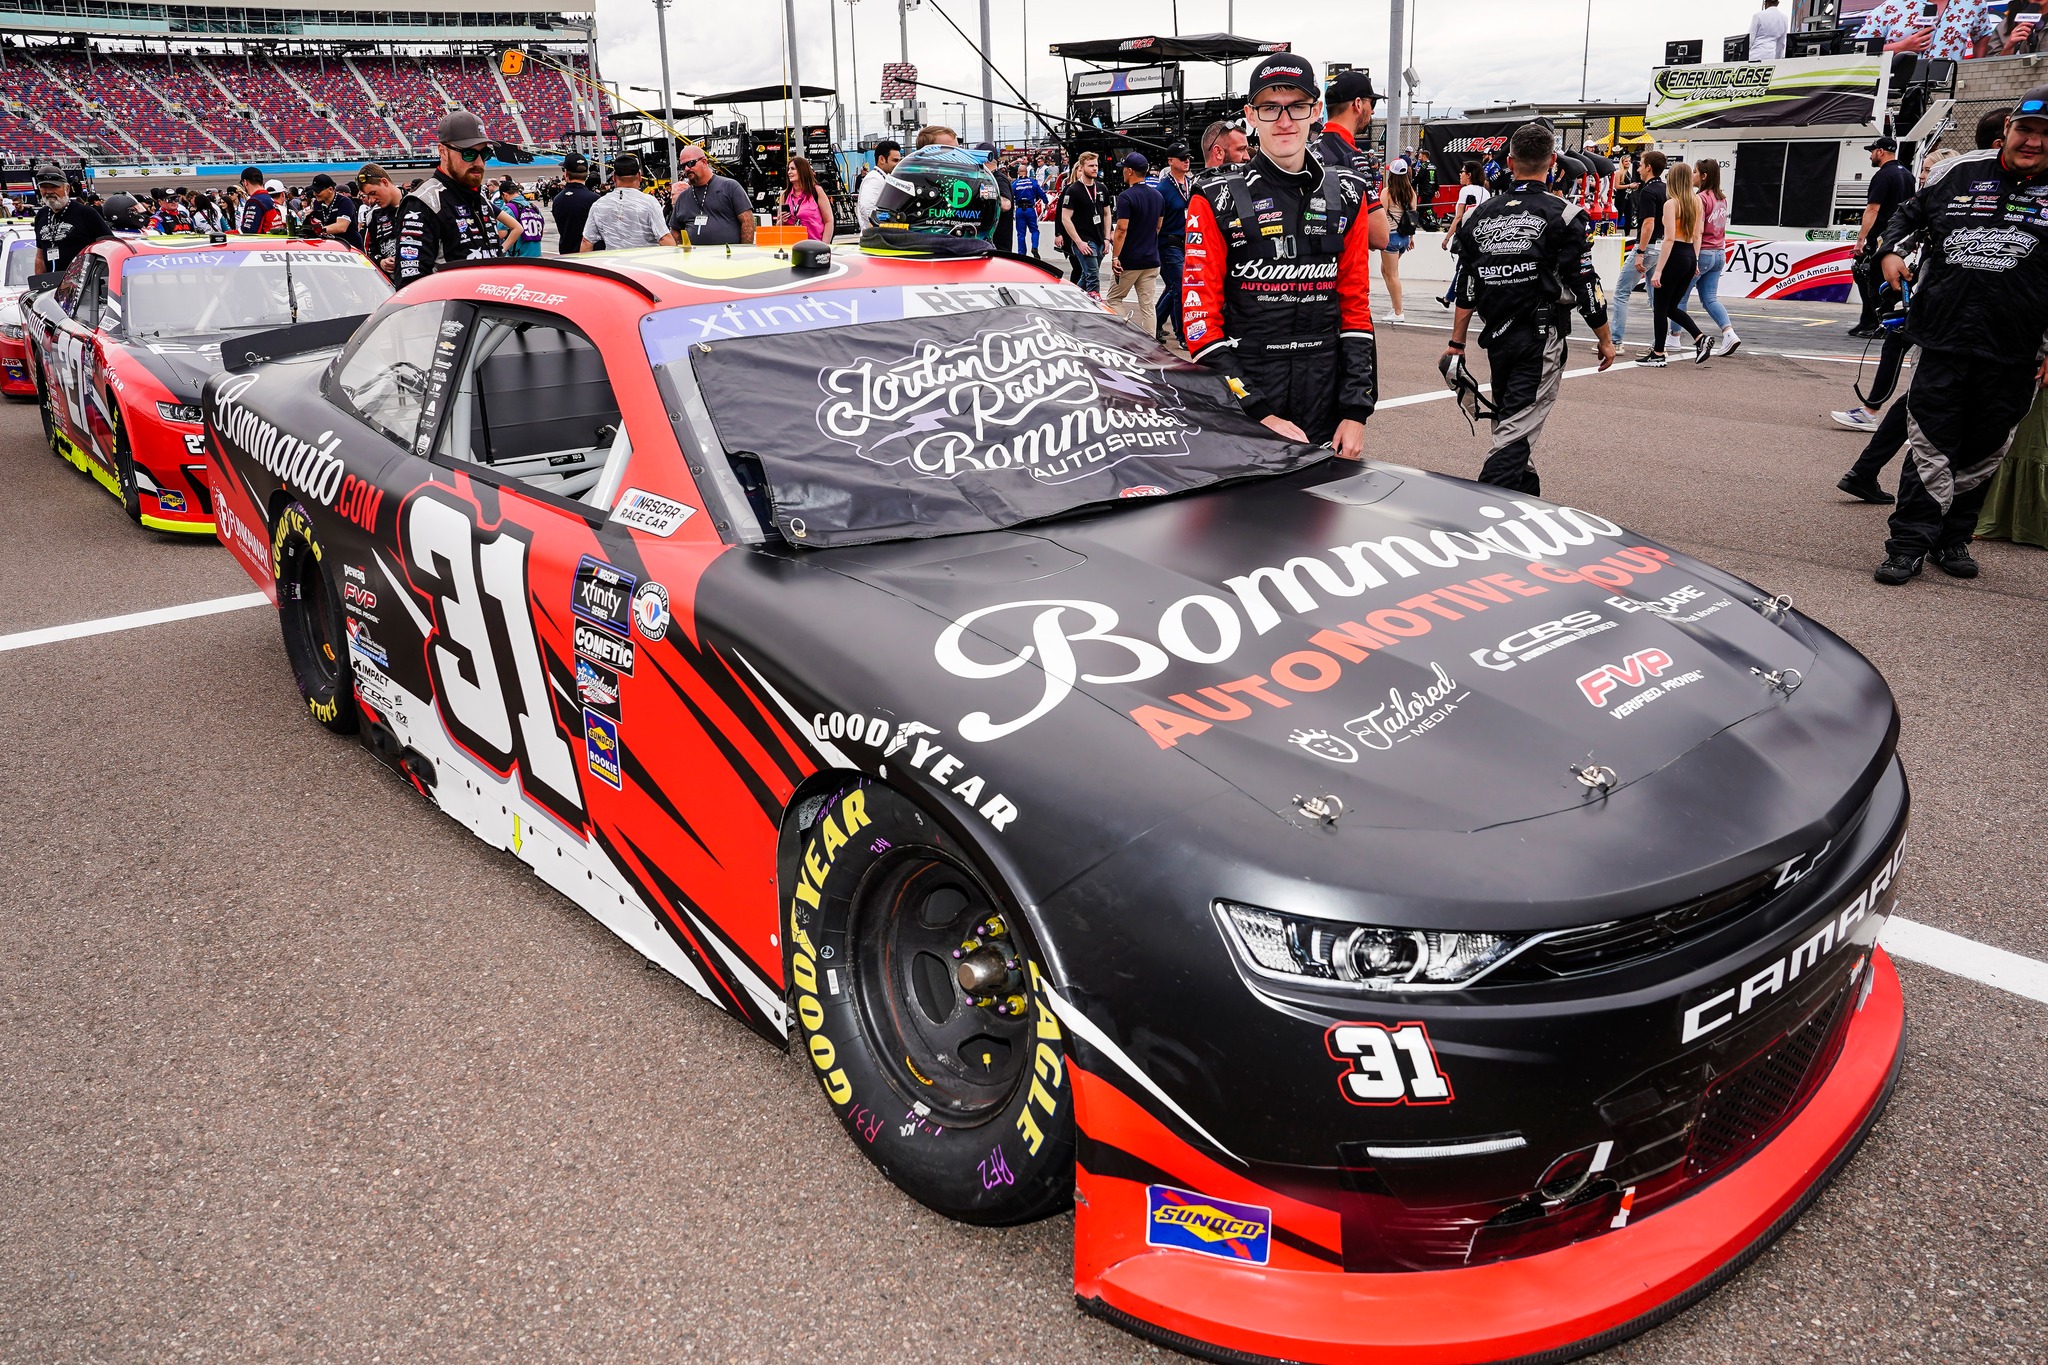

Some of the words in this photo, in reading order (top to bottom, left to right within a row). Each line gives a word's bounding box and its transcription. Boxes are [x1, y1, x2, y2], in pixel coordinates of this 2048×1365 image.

[1132, 37, 1155, 49] RCR
[1259, 65, 1303, 78] Bommarito
[1685, 87, 1769, 102] Motorsports
[709, 139, 739, 157] JARRETT
[1465, 136, 1508, 152] RCR
[1718, 160, 1730, 168] ps
[928, 208, 981, 219] FUNKAWAY
[1189, 232, 1203, 244] 75
[1480, 238, 1532, 251] Bommarito
[1943, 227, 1986, 247] Jordan
[1980, 226, 2037, 250] Anderson
[146, 254, 225, 269] xfinity
[260, 252, 358, 264] BURTON
[1478, 262, 1537, 278] EASYCARE
[1948, 250, 2018, 268] Bommarito
[1240, 281, 1314, 292] AUTOMOTIVE
[1775, 276, 1797, 291] Made
[1797, 272, 1805, 283] in
[1806, 265, 1840, 278] America
[475, 283, 508, 297] PARKER
[518, 290, 568, 306] RETZLAFF
[689, 294, 860, 338] xfinity
[1298, 340, 1323, 348] RETZLAFF
[827, 344, 982, 437] Jordan
[948, 359, 1099, 442] Racing
[913, 403, 1187, 474] Bommarito
[1033, 430, 1179, 480] AUTOSPORT
[160, 495, 185, 506] SUNOCO
[640, 495, 681, 520] NASCAR
[620, 509, 645, 525] RACE
[645, 514, 668, 531] CAR
[228, 508, 271, 571] FUNKAWAY
[343, 563, 366, 585] pewag
[599, 568, 620, 585] NASCAR
[343, 582, 377, 609] FVP
[581, 579, 622, 618] xfinity
[1604, 584, 1706, 614] ECARE
[590, 605, 609, 620] SERIES
[933, 500, 1624, 743] Bommarito
[634, 613, 665, 640] ANNIVERSARY
[1499, 610, 1602, 652] CRS
[409, 495, 584, 811] 31
[575, 627, 633, 668] COMETIC
[579, 647, 602, 660] GASKET
[1129, 573, 1550, 750] AUTOMOTIVE
[1527, 546, 1676, 594] GOUP
[362, 664, 390, 687] IMPACT
[576, 666, 619, 698] Arrowhead
[1576, 648, 1674, 708] FVP
[309, 695, 338, 723] EAGLE
[361, 684, 393, 710] CRS
[1344, 661, 1457, 750] Tailored
[1609, 682, 1666, 720] VERIFIED.
[1410, 702, 1458, 737] MEDIA
[589, 729, 615, 750] SUNOCO
[589, 750, 619, 775] ROOKIE
[1682, 829, 1908, 1044] CAMARO
[1016, 958, 1065, 1157] EAGLE
[1333, 1024, 1451, 1100] 31
[1160, 1207, 1265, 1238] SUNOCO
